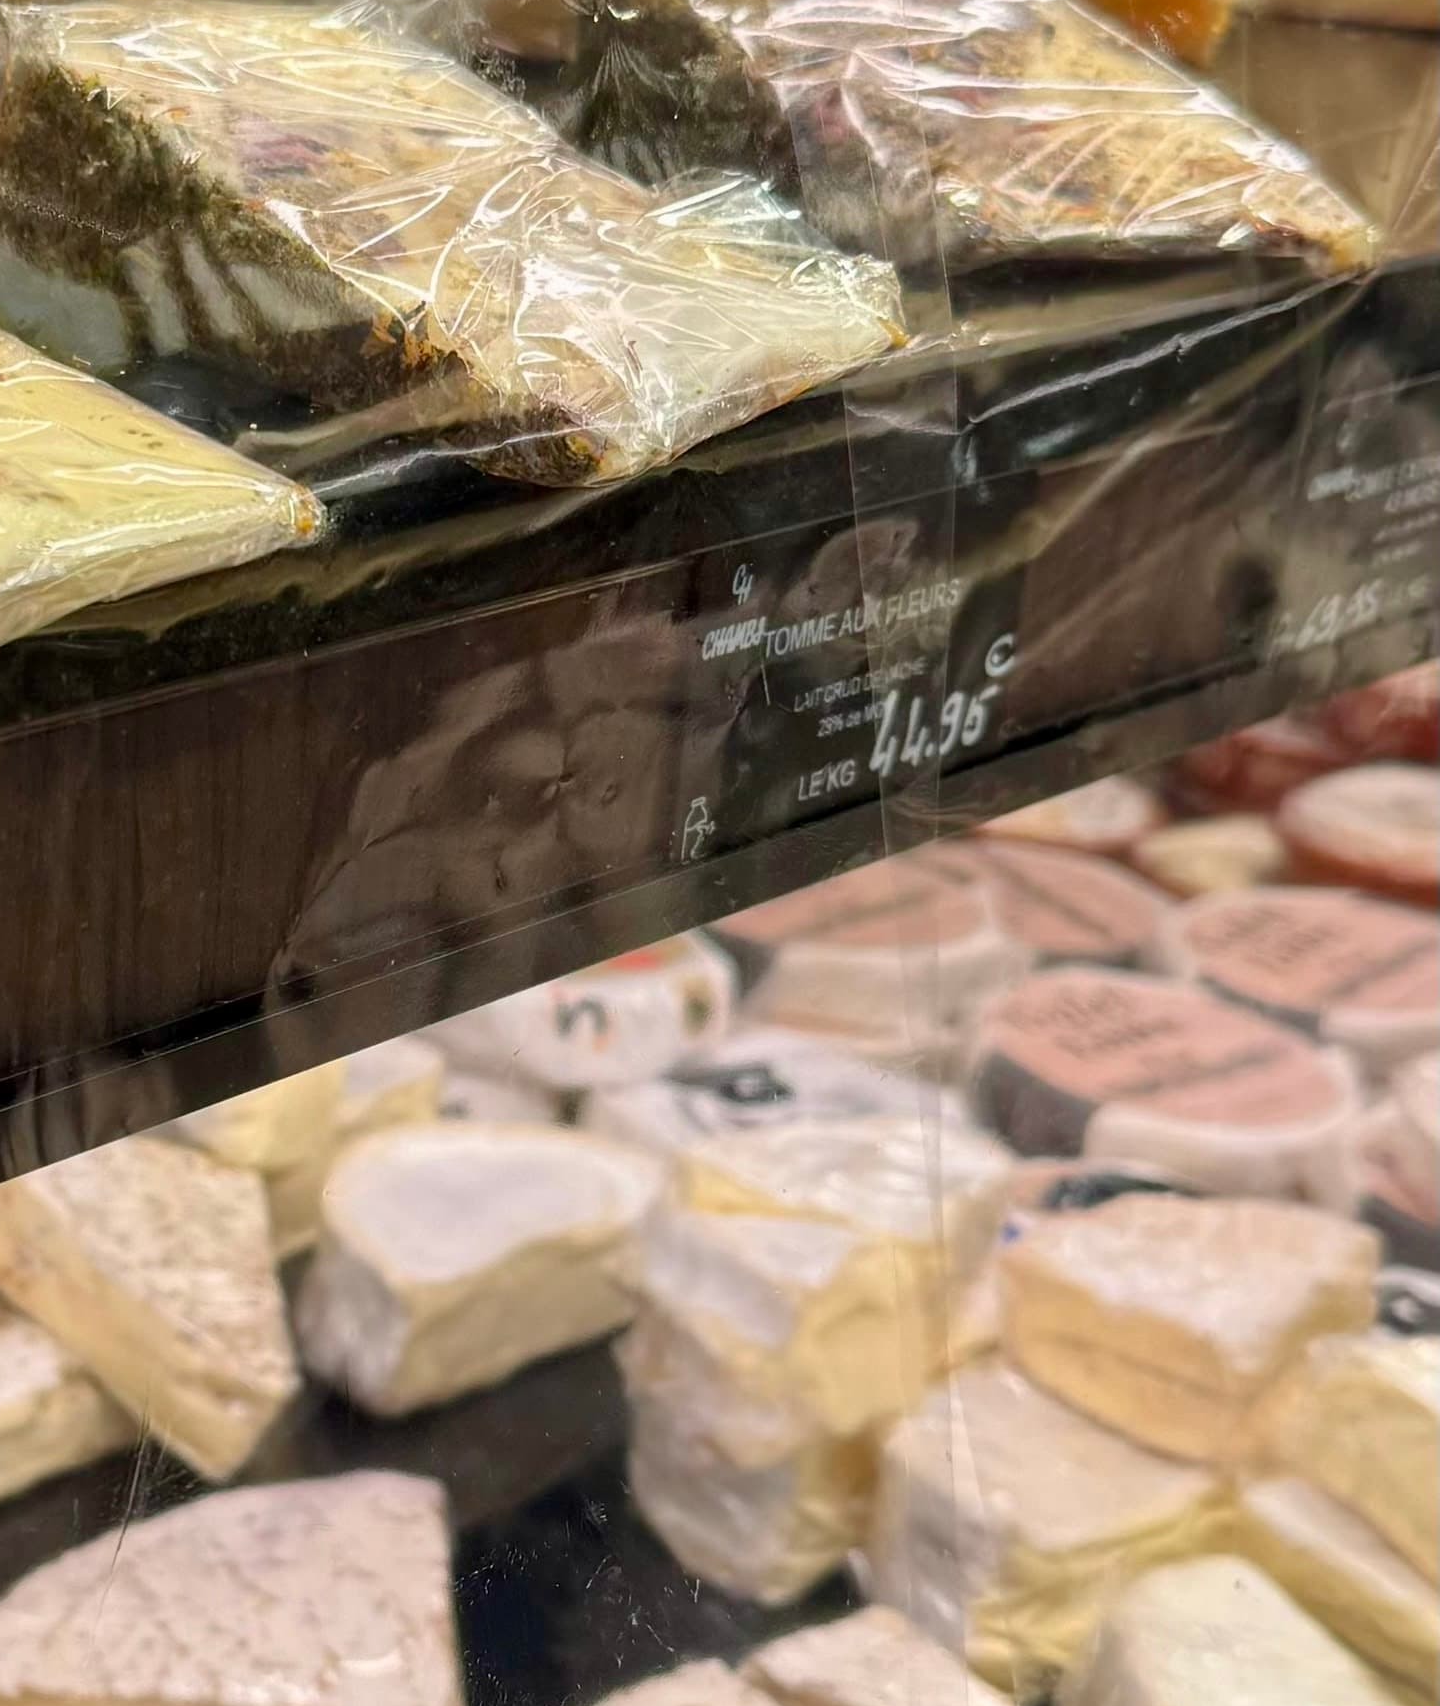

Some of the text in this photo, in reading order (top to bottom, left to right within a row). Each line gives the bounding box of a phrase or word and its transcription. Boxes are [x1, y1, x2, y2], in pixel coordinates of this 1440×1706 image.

[764, 579, 959, 658] TOMME AUX FLEURS
[798, 684, 1000, 801] LE KG 44.95
